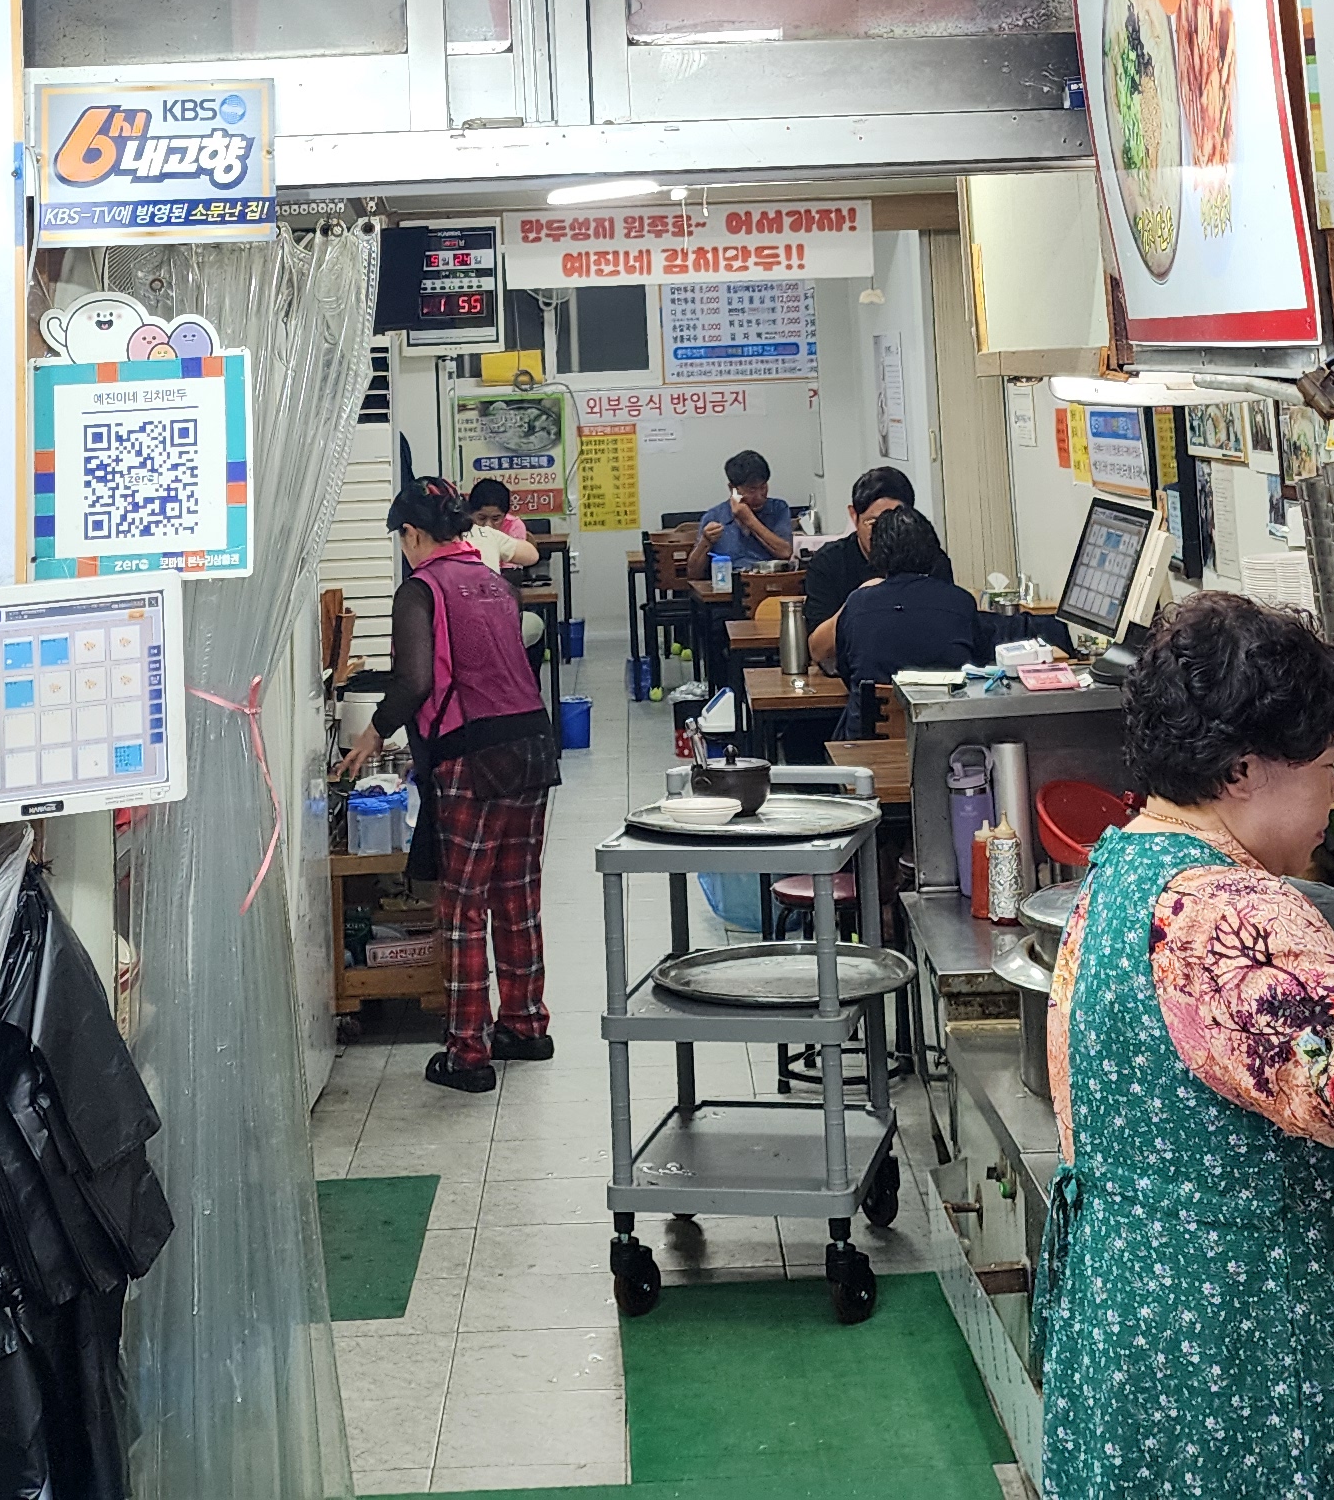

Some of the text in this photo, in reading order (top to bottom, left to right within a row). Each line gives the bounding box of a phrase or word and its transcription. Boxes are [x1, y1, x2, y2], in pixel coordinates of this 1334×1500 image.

[162, 98, 218, 123] KBS
[118, 129, 249, 185] 내고향
[43, 199, 270, 226] KBS-TV에 방영된 소문난 집!
[520, 215, 616, 245] 만두성지
[724, 206, 859, 236] 어서가자!
[561, 242, 807, 279] 예진네 김치만두!!
[92, 385, 188, 408] 예진이네 김치만두
[584, 387, 749, 419] 외부음식 반입금지
